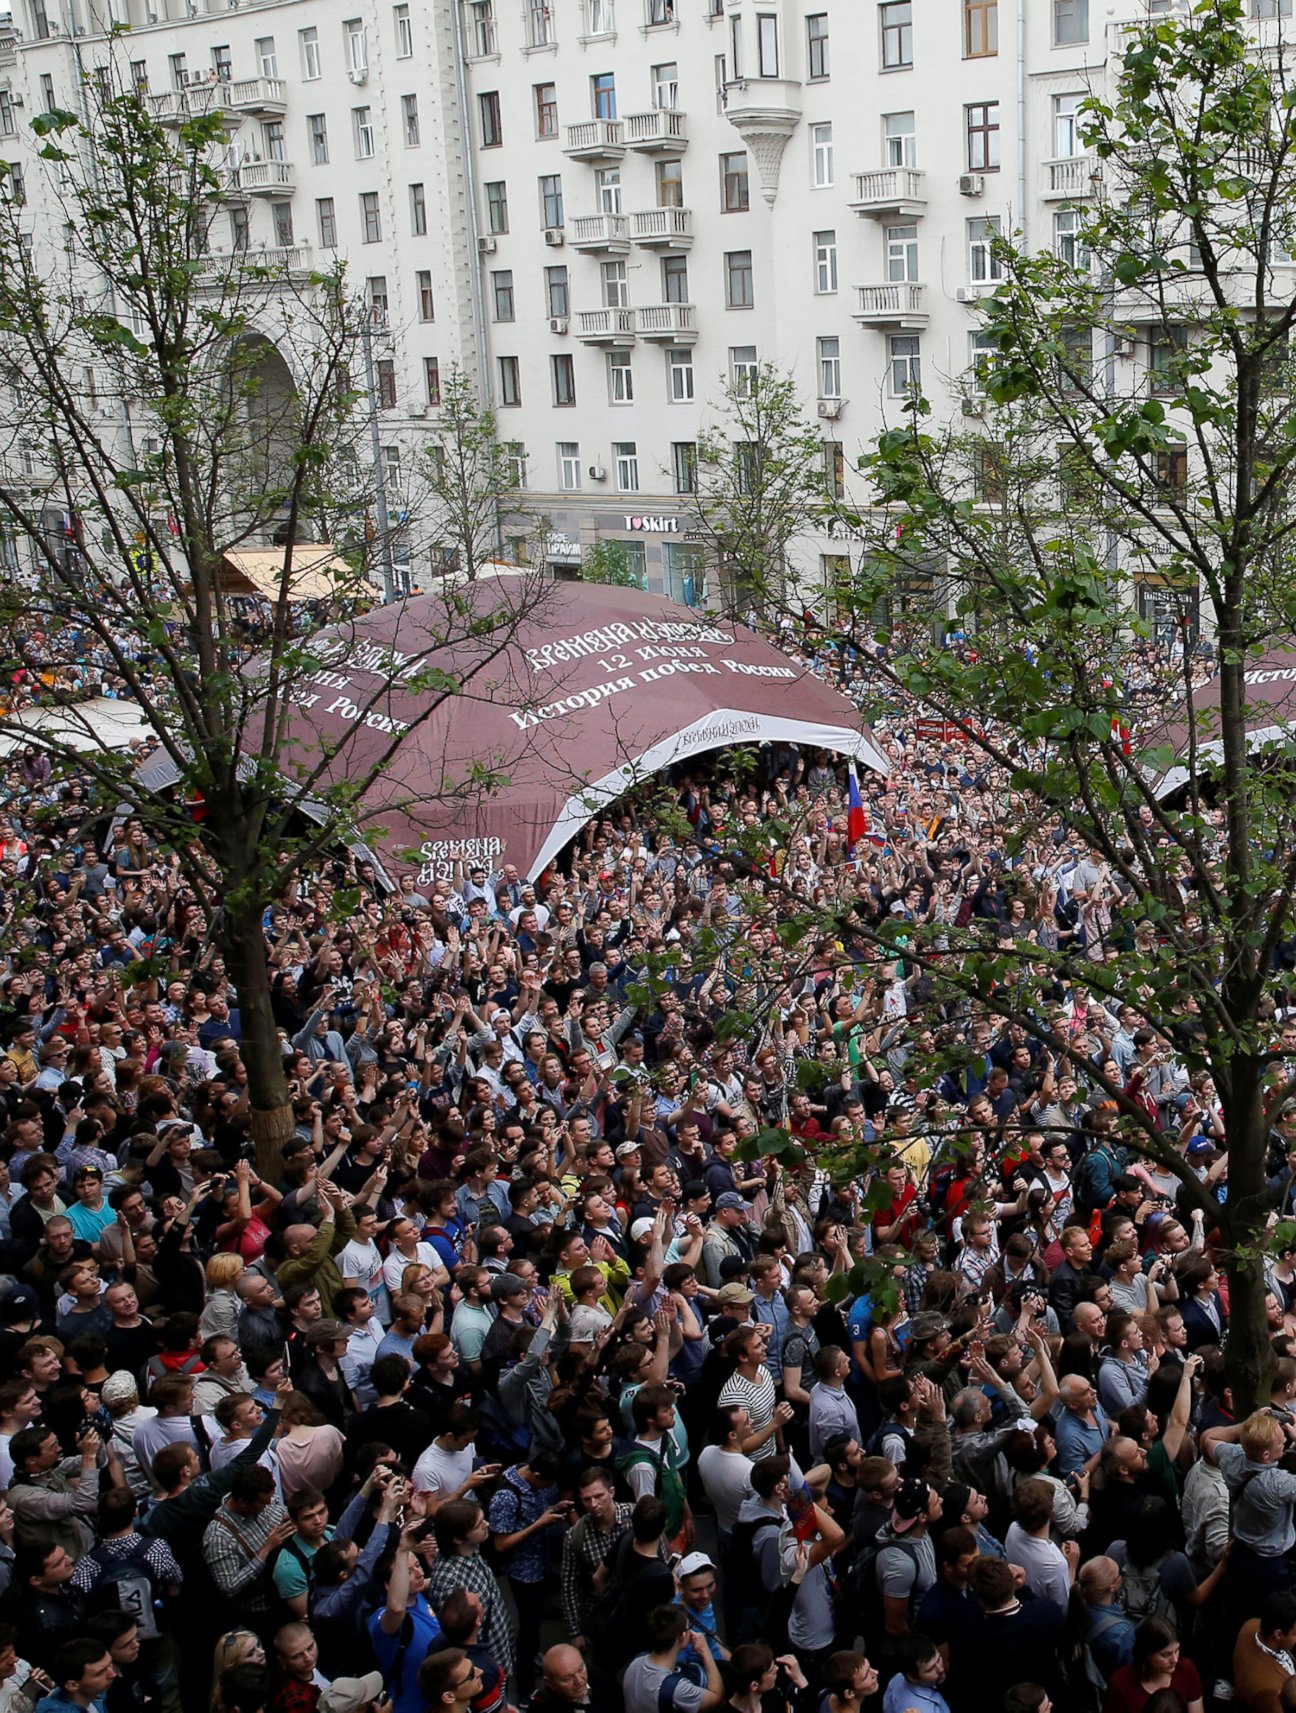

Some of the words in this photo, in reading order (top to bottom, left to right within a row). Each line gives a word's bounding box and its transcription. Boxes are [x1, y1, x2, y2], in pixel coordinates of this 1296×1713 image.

[597, 654, 632, 673] 12
[508, 677, 637, 730] История
[637, 659, 722, 683] побед
[720, 659, 798, 678] России
